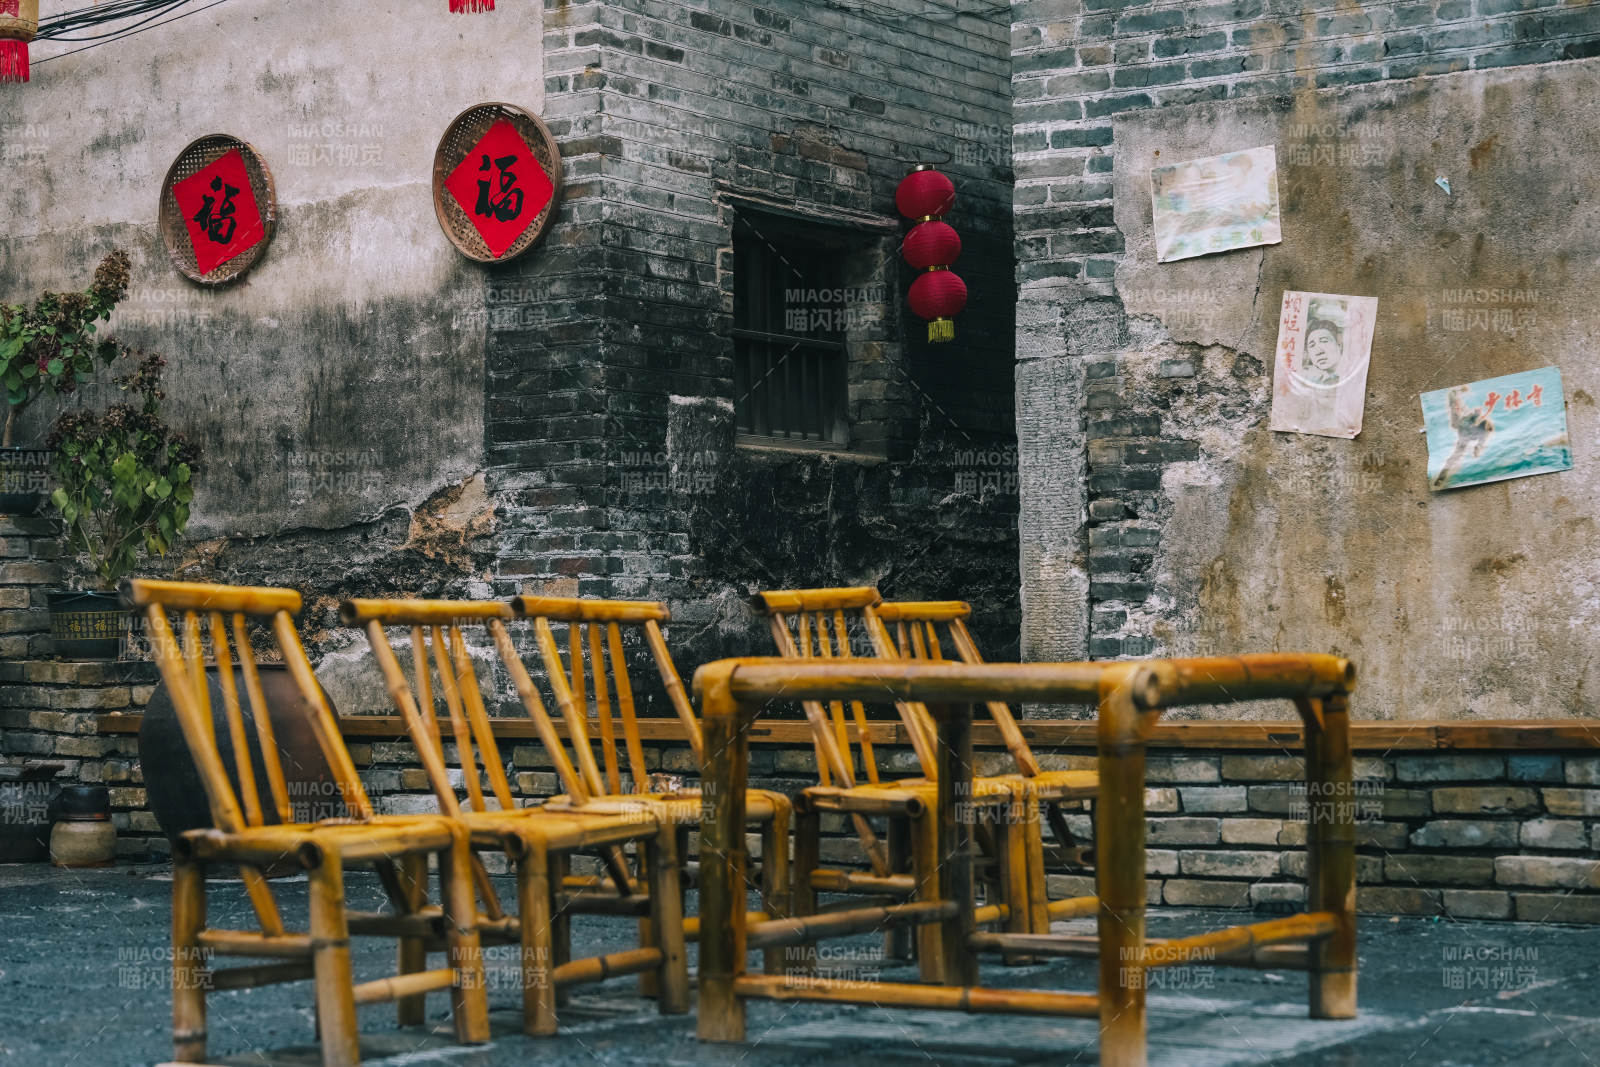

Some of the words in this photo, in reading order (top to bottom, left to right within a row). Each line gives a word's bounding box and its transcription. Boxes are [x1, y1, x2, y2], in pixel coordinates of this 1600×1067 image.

[193, 175, 240, 245] 福
[475, 154, 524, 223] 福
[1484, 384, 1543, 417] 少林寺
